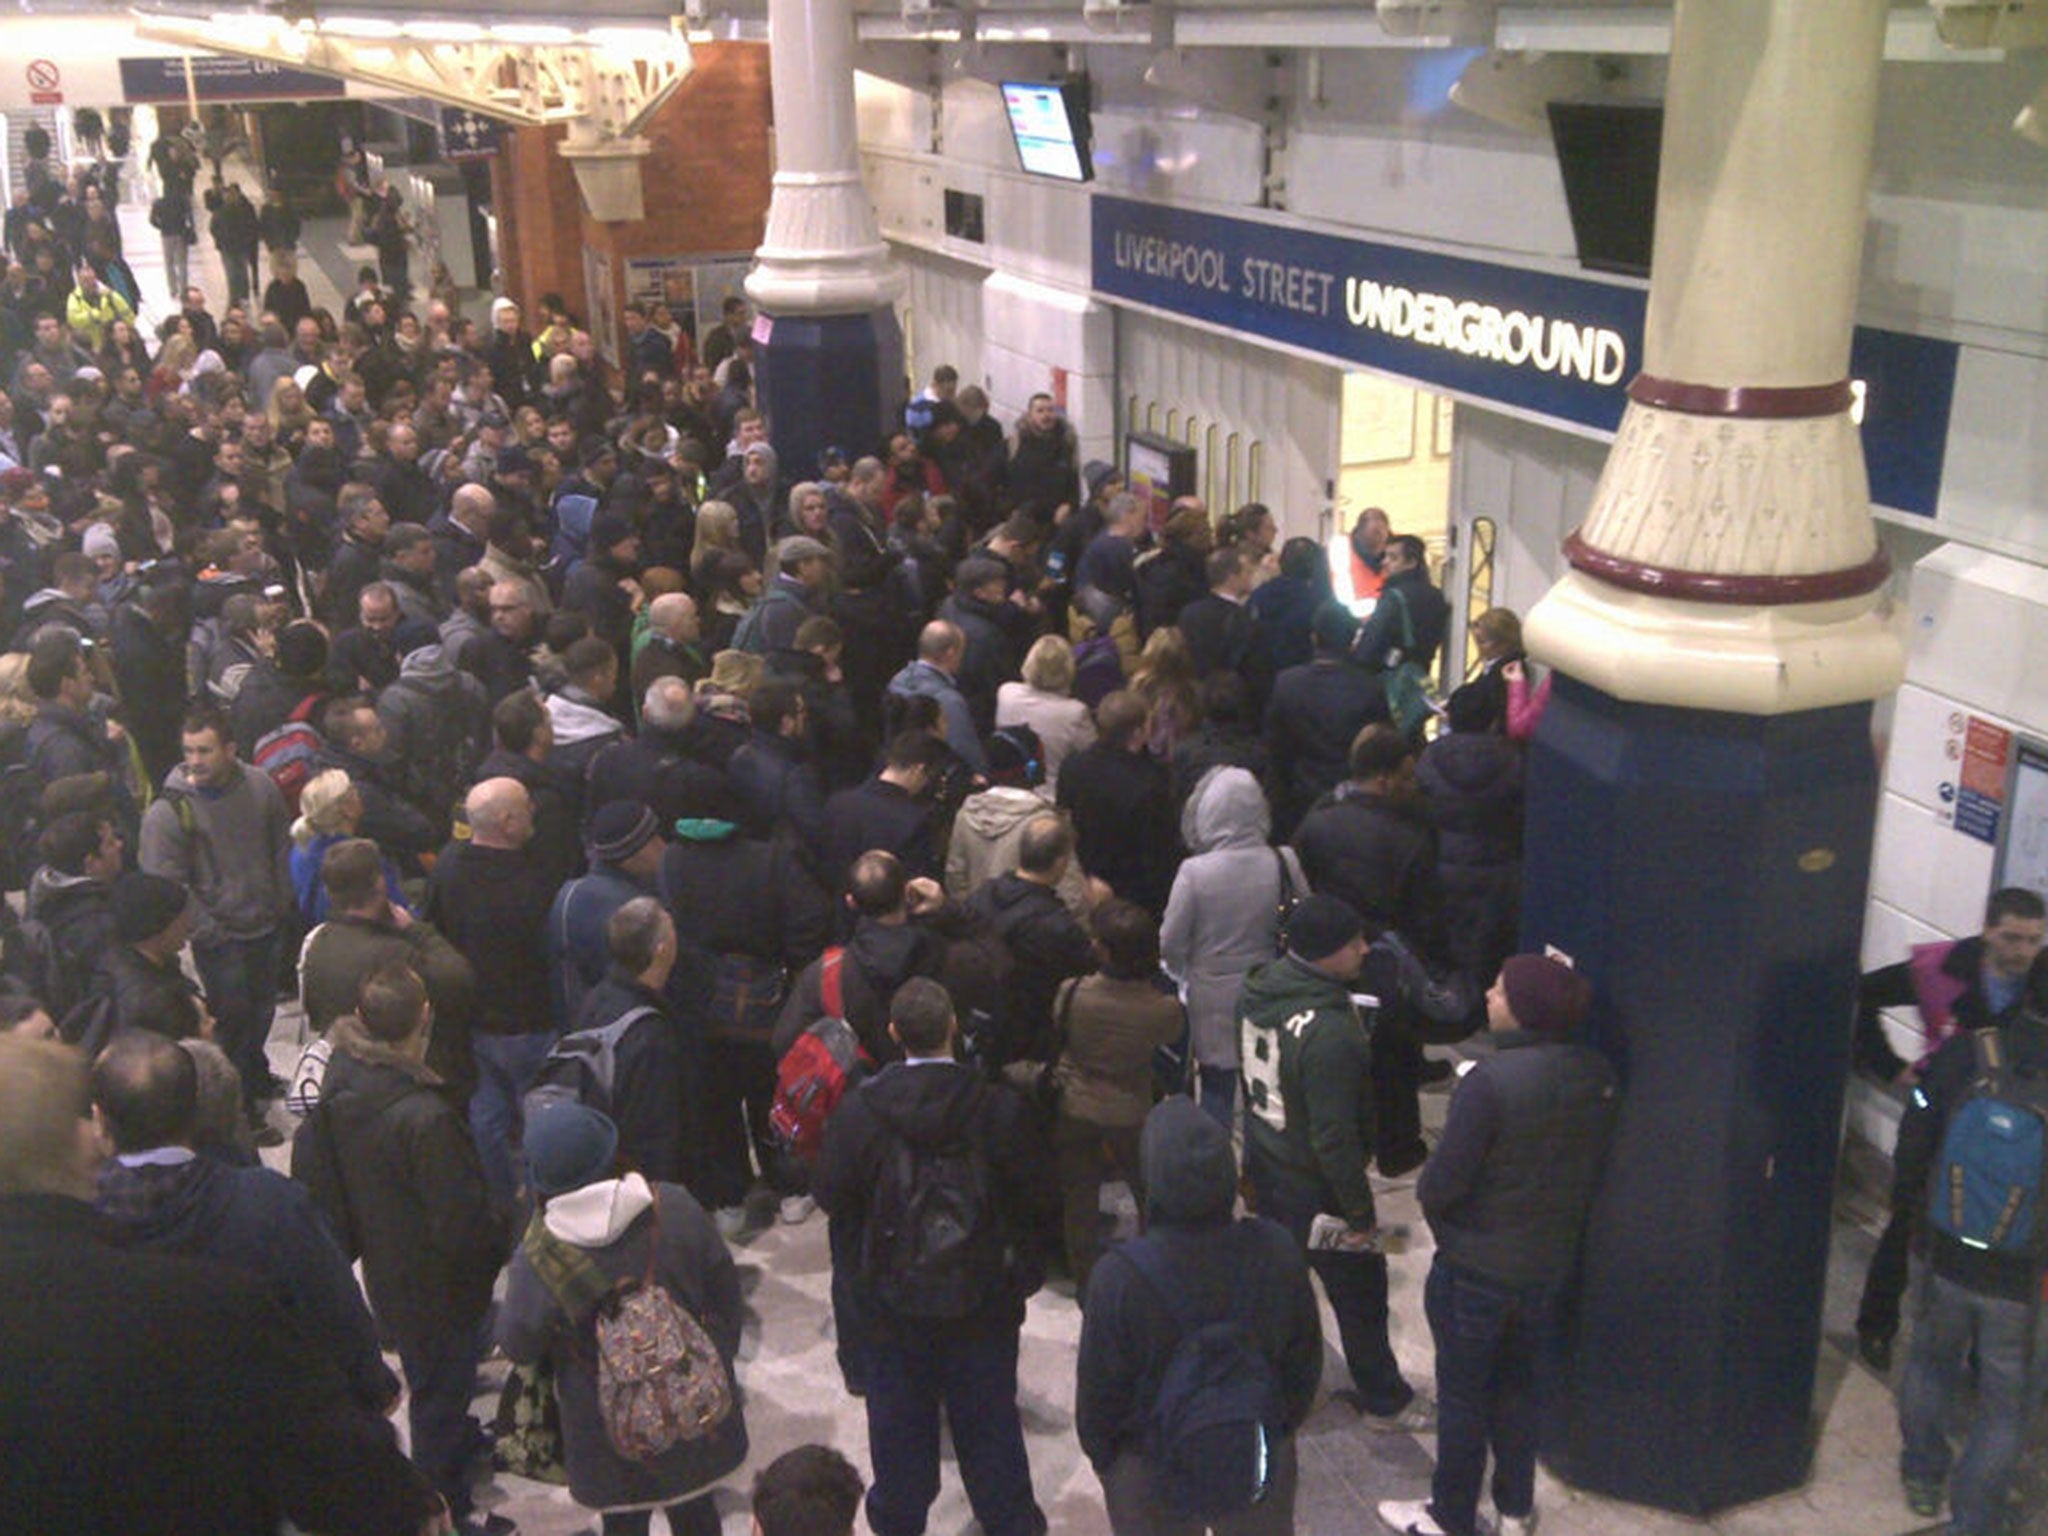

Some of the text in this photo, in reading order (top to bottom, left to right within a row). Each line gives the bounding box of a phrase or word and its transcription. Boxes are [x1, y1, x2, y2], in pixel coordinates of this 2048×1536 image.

[1114, 230, 1626, 386] LIVERPOOL STREET UNDERGROUND
